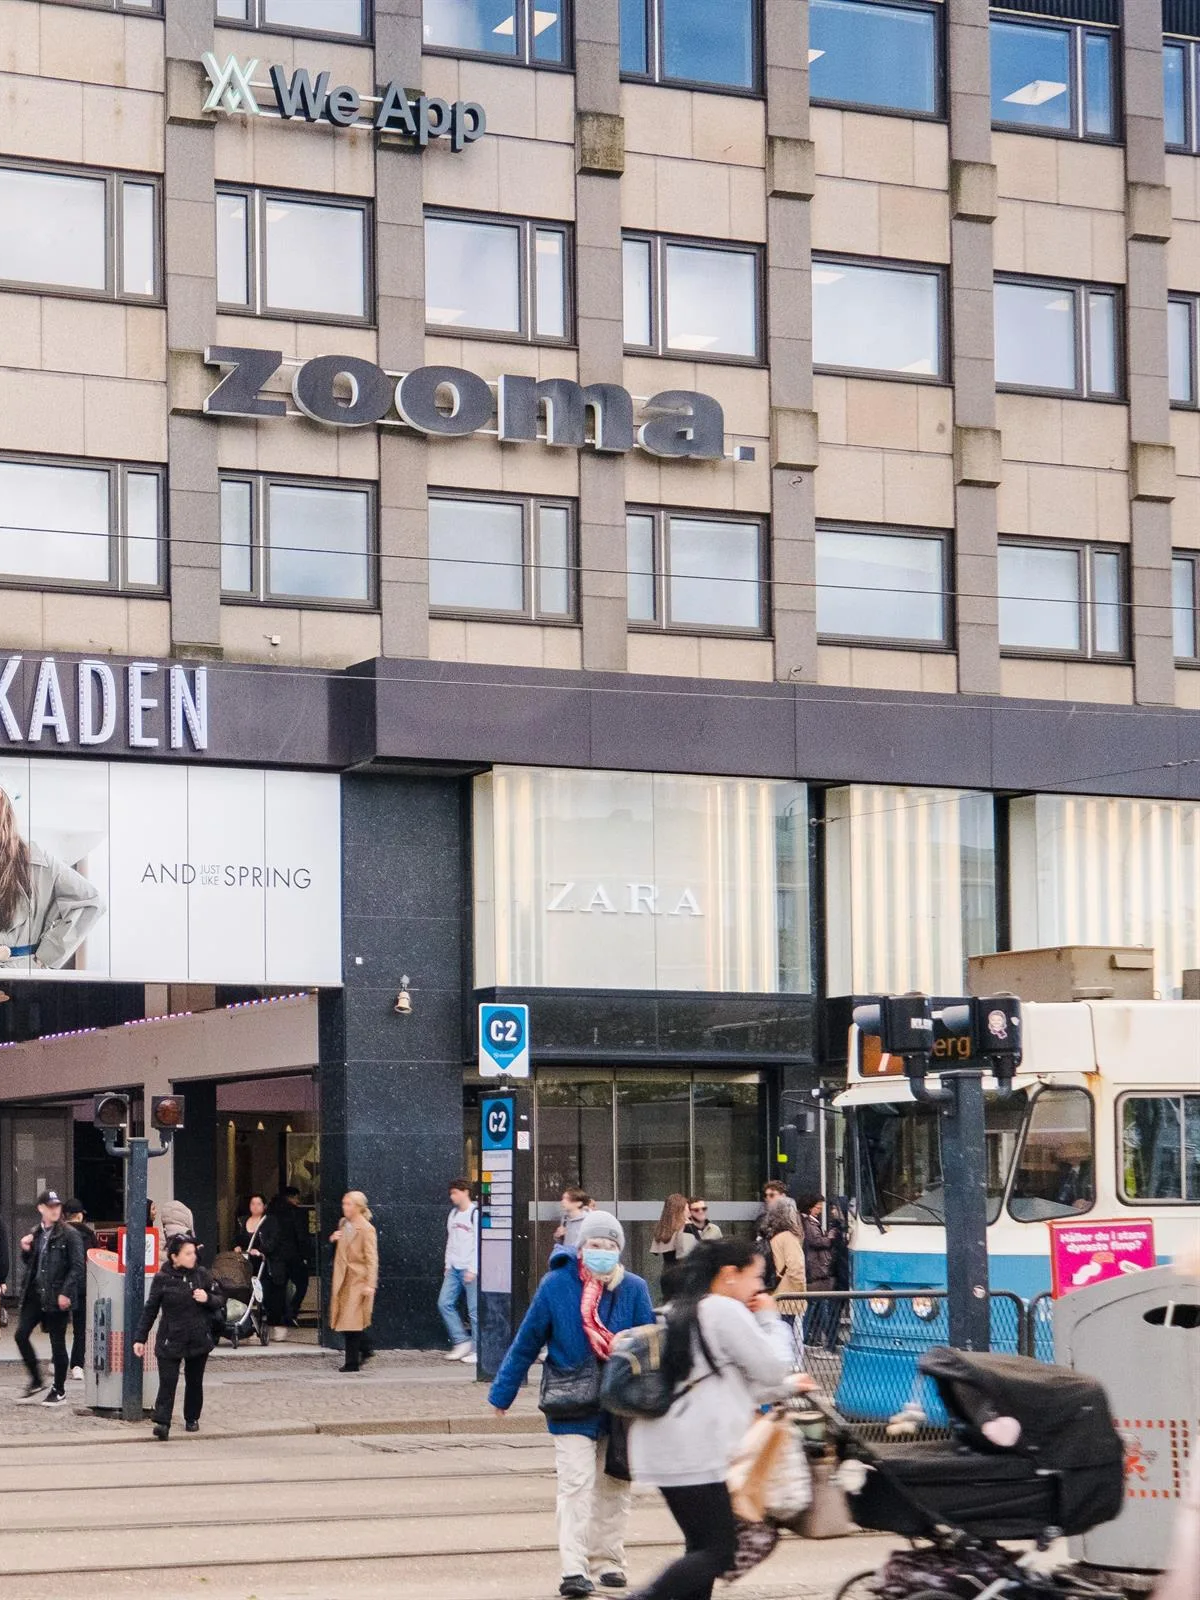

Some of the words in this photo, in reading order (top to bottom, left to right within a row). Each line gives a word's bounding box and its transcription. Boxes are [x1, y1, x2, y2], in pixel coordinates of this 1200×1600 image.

[269, 64, 360, 127] We
[375, 81, 487, 152] App
[141, 862, 196, 885] AND
[200, 864, 220, 875] JUST
[201, 875, 219, 886] LIKE
[224, 865, 312, 889] SPRING
[546, 881, 705, 917] ZARA
[490, 1020, 518, 1042] C2
[488, 1111, 507, 1133] C2
